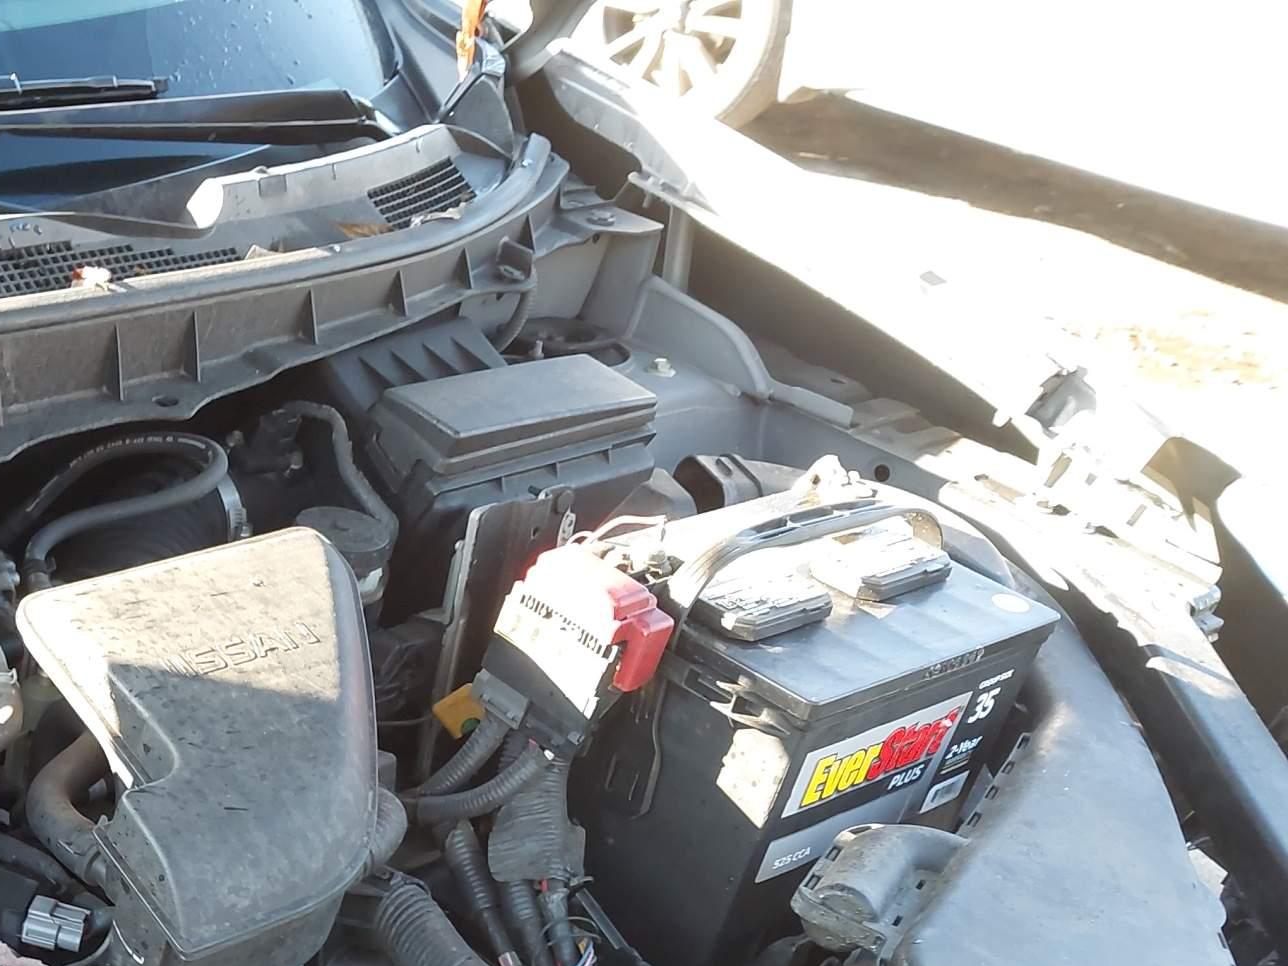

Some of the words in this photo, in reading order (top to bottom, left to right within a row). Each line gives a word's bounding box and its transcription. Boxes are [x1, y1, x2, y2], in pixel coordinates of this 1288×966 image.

[967, 686, 1002, 724] 35
[799, 706, 961, 809] EverStart
[887, 763, 925, 791] PLUS
[792, 846, 811, 862] CCA
